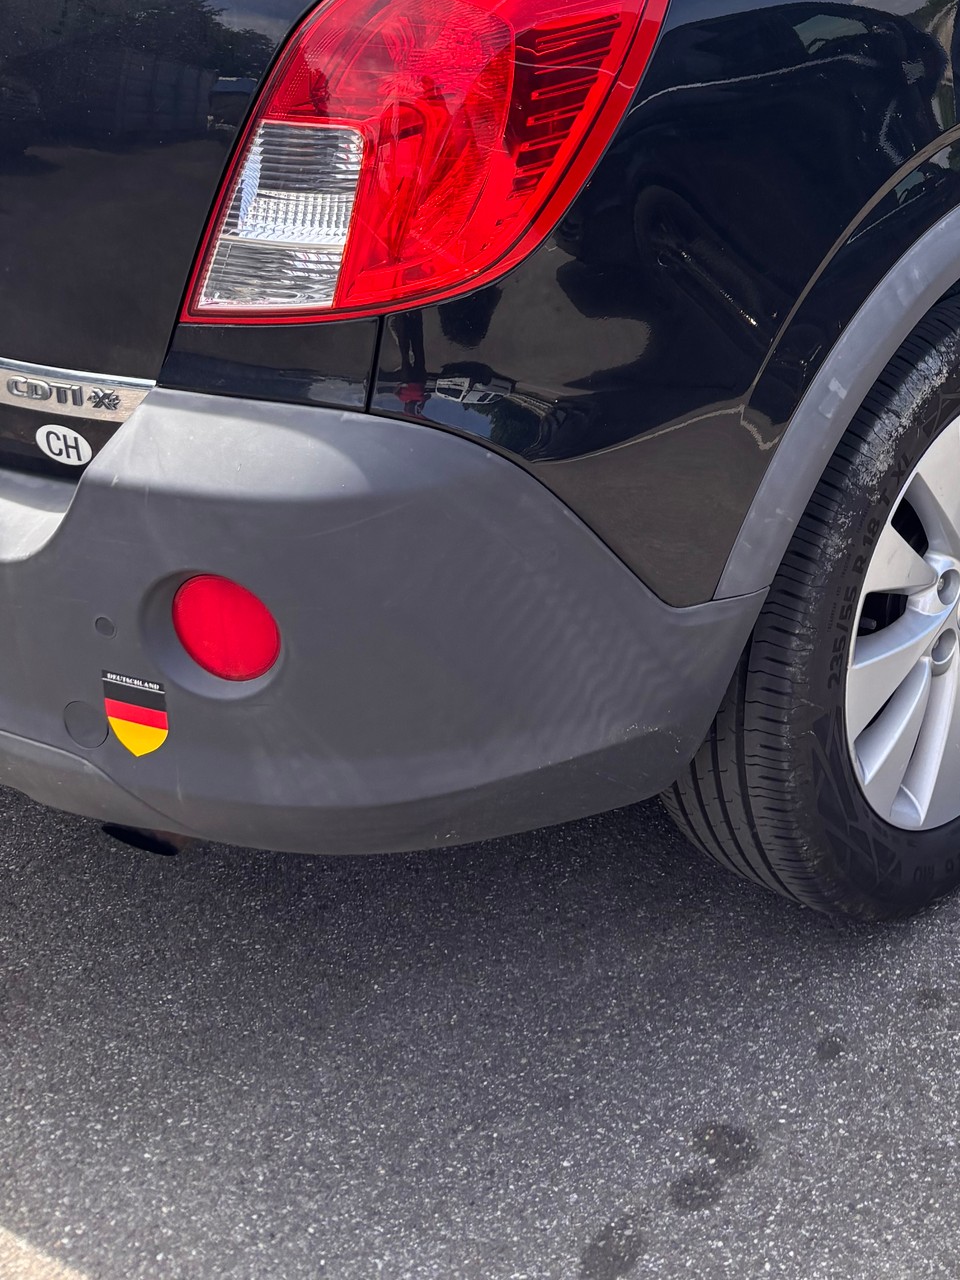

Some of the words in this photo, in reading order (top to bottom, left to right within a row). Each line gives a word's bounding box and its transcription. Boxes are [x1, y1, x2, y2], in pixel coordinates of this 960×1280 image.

[7, 375, 83, 406] CDTI
[46, 431, 82, 461] CH
[827, 585, 858, 690] 235/55
[851, 554, 869, 575] R
[862, 517, 882, 547] 18
[890, 453, 914, 489] XL
[106, 672, 160, 690] DEUTSCHLAND
